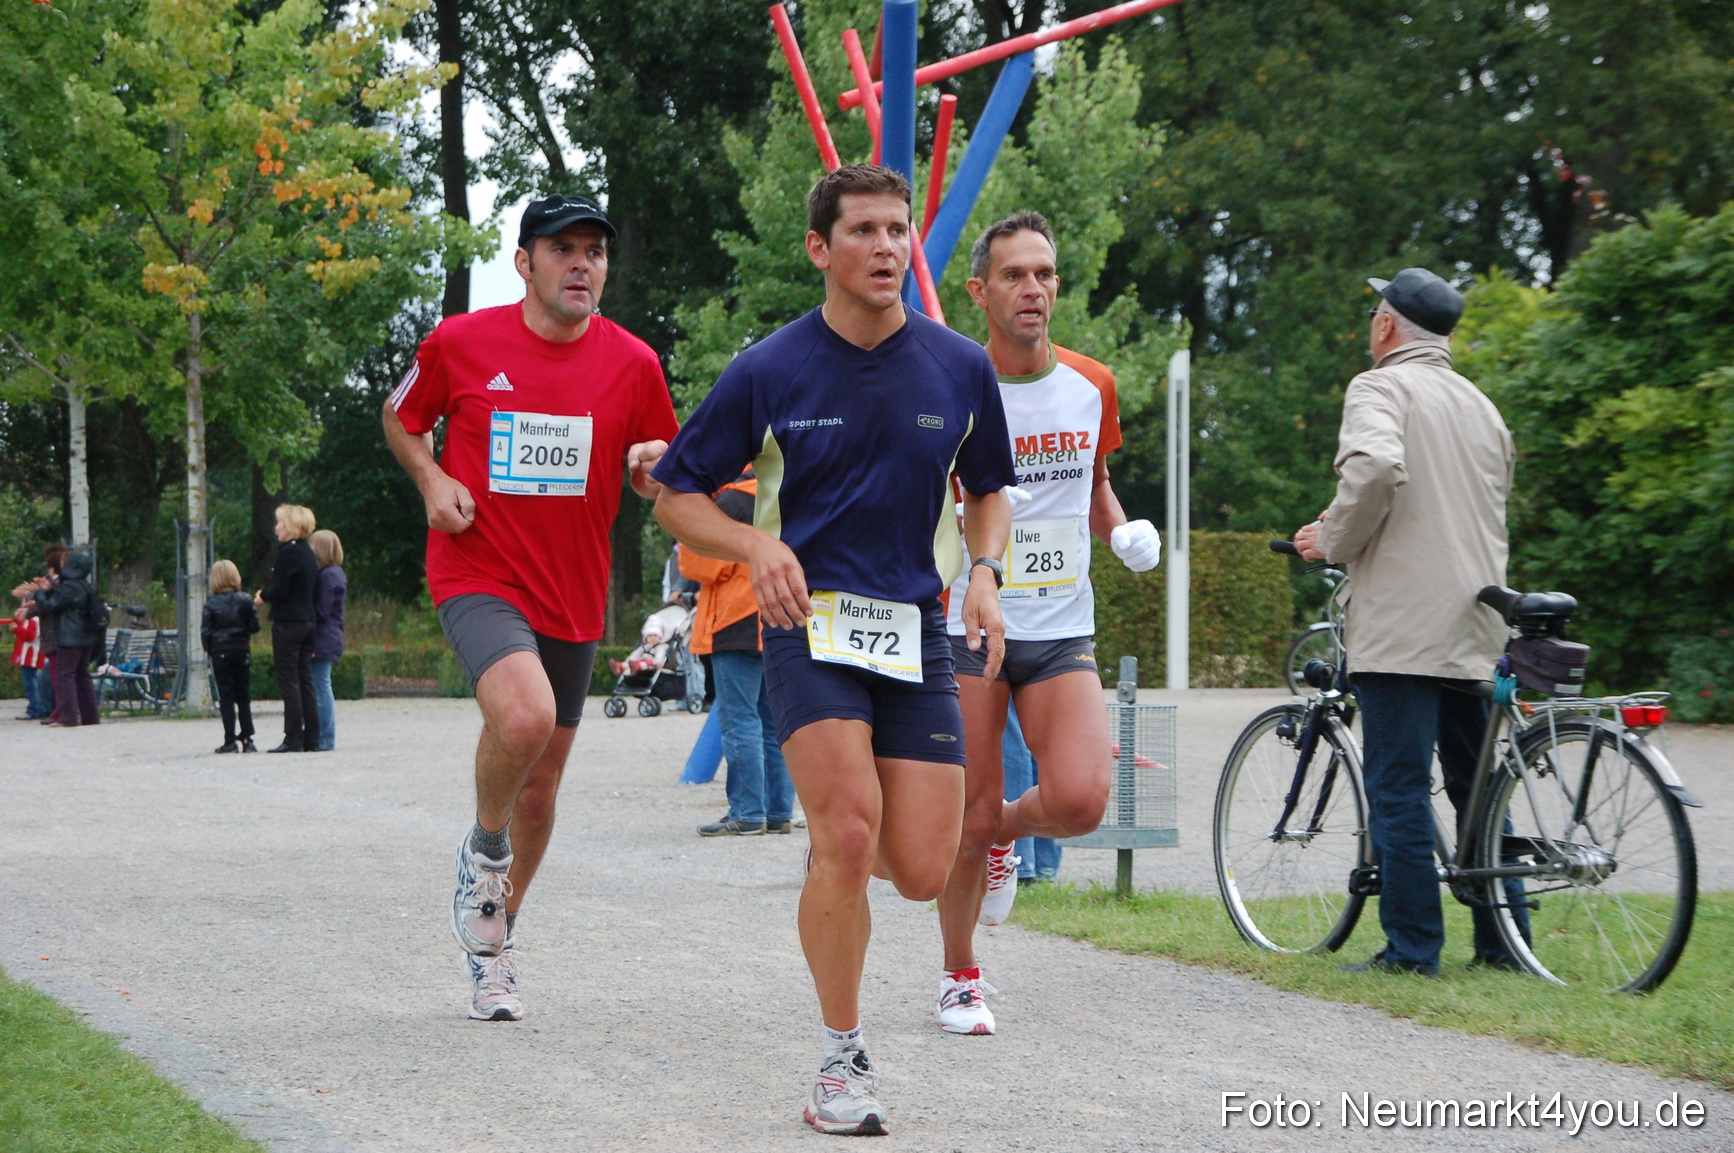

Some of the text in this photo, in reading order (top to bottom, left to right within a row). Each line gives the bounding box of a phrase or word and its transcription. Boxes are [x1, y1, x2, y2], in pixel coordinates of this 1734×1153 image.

[519, 420, 569, 438] Manfred
[789, 418, 843, 428] SPORT STADL
[496, 441, 503, 452] A
[1014, 431, 1091, 456] MERZ
[519, 444, 579, 467] 2005
[1016, 468, 1083, 484] EAM 2008
[1015, 529, 1040, 543] Uwe
[1025, 550, 1064, 574] 283
[839, 598, 893, 620] Markus
[812, 621, 819, 631] A
[848, 628, 900, 656] 572
[878, 665, 920, 678] PFLEIDERER
